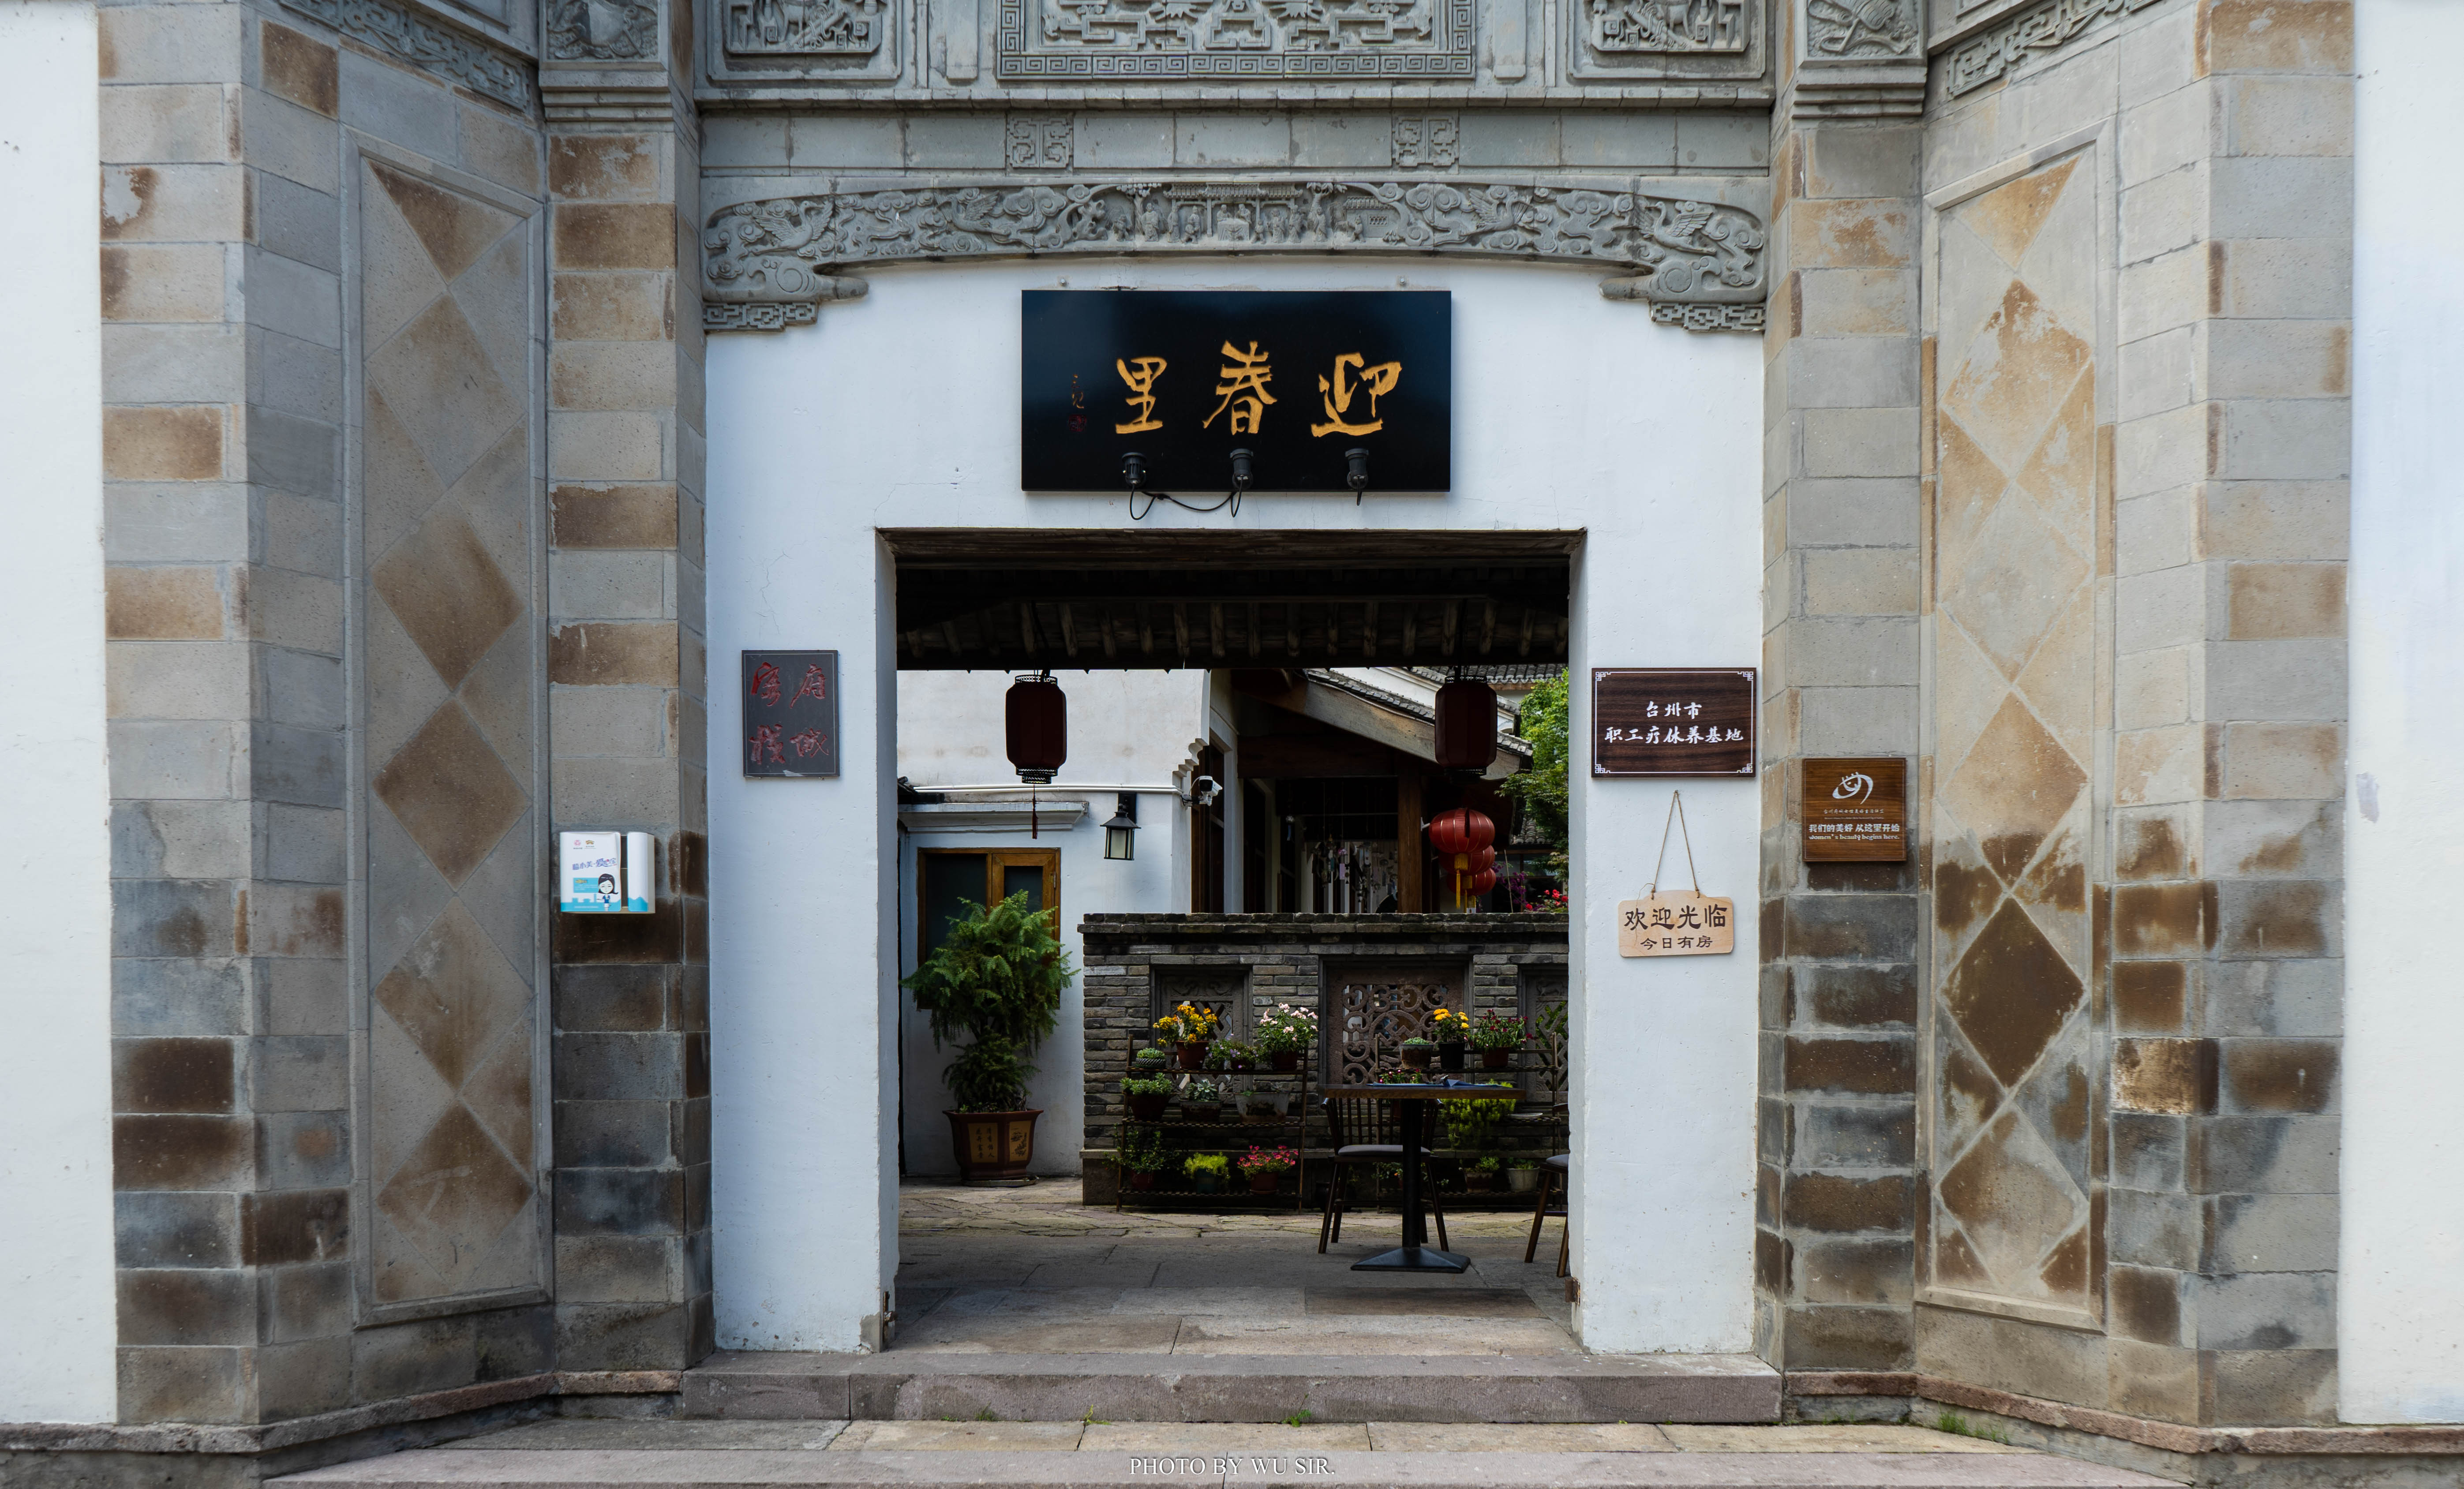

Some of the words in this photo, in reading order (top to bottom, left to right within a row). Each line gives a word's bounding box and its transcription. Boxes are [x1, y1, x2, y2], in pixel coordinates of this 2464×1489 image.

[1115, 340, 1403, 437] 迎春里
[1646, 701, 1702, 719] 台州市
[1604, 725, 1744, 744] 职工疗休养基地
[1809, 824, 1854, 833] 我们的美好
[1855, 823, 1900, 833] 从这里开始
[1624, 904, 1727, 931] 欢迎光临
[1640, 935, 1713, 950] 今日有房
